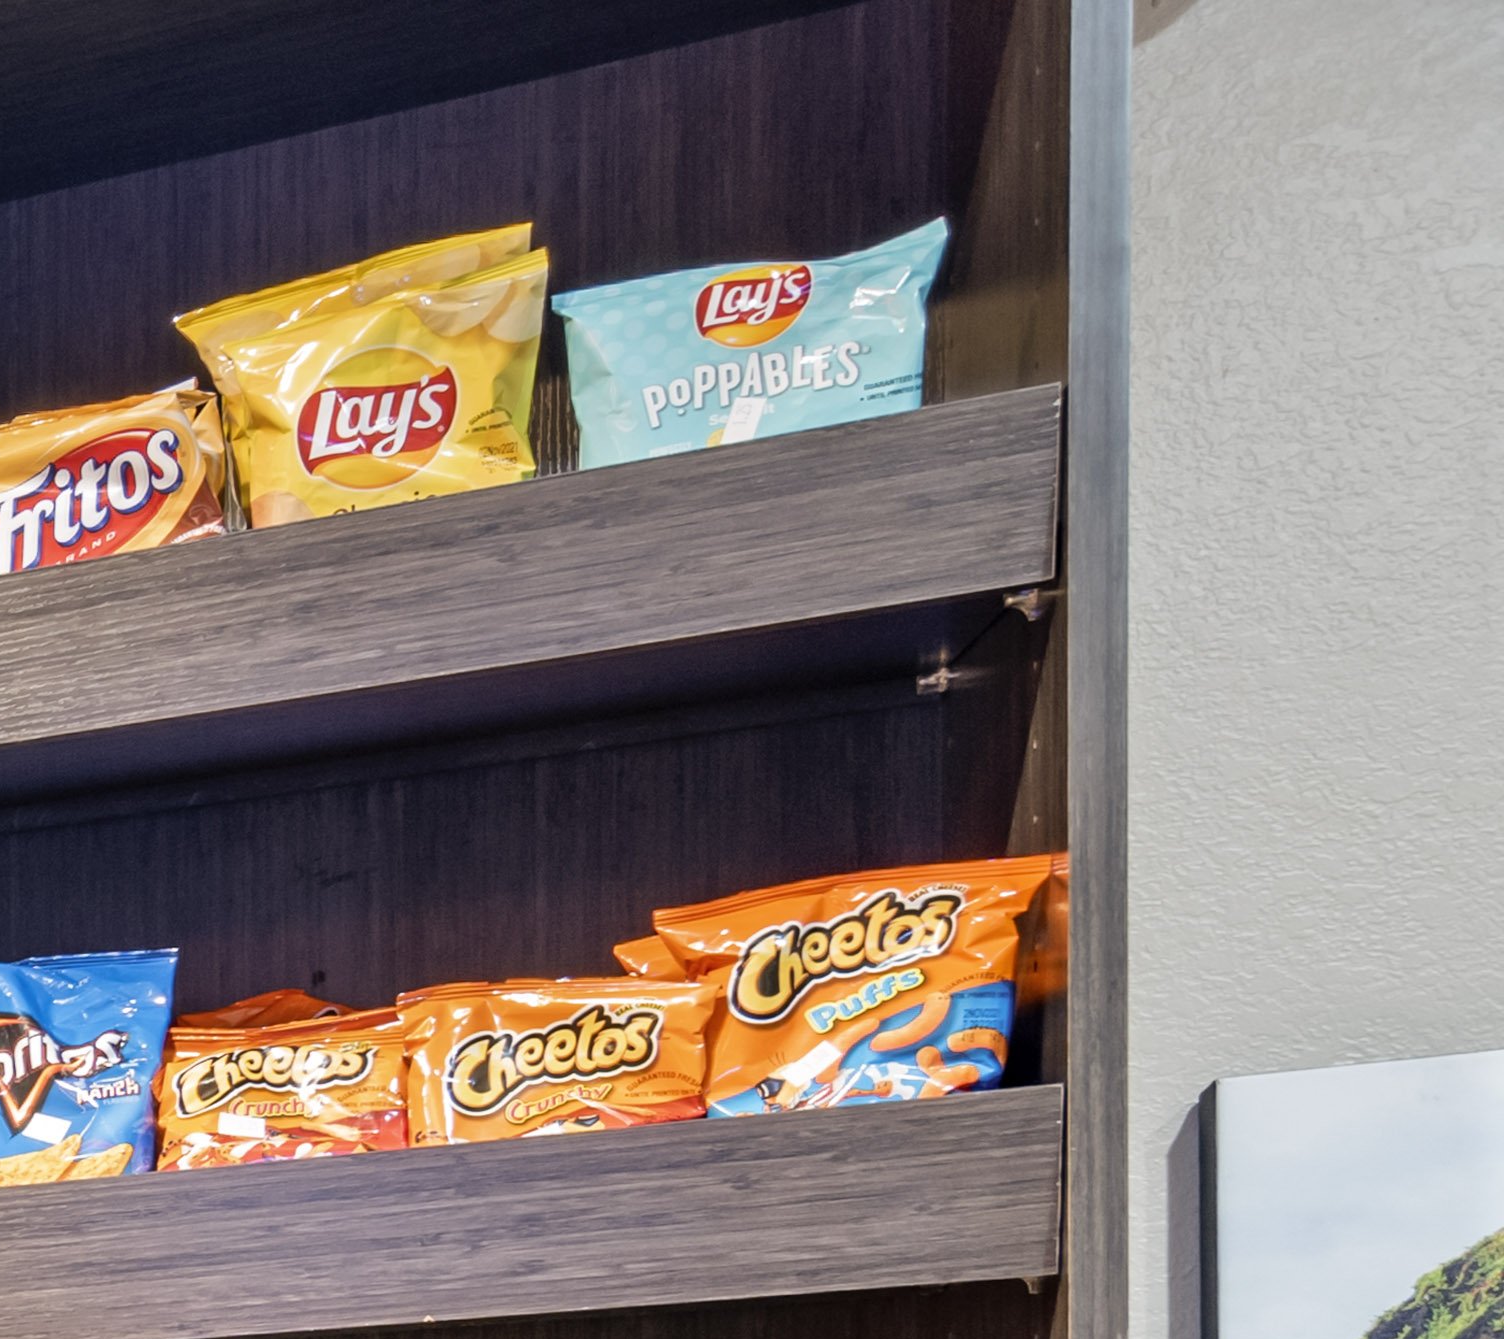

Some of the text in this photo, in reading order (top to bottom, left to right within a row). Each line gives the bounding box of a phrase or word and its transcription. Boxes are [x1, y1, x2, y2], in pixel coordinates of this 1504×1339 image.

[698, 266, 813, 332] Lay's
[309, 374, 450, 460] Lay's
[641, 340, 861, 429] POPPABLES
[729, 892, 966, 1027] Cheetos
[804, 967, 926, 1034] Puffs
[176, 1036, 375, 1118] Cheetos
[450, 1006, 663, 1115] Cheetos
[505, 1080, 612, 1125] Crunchy
